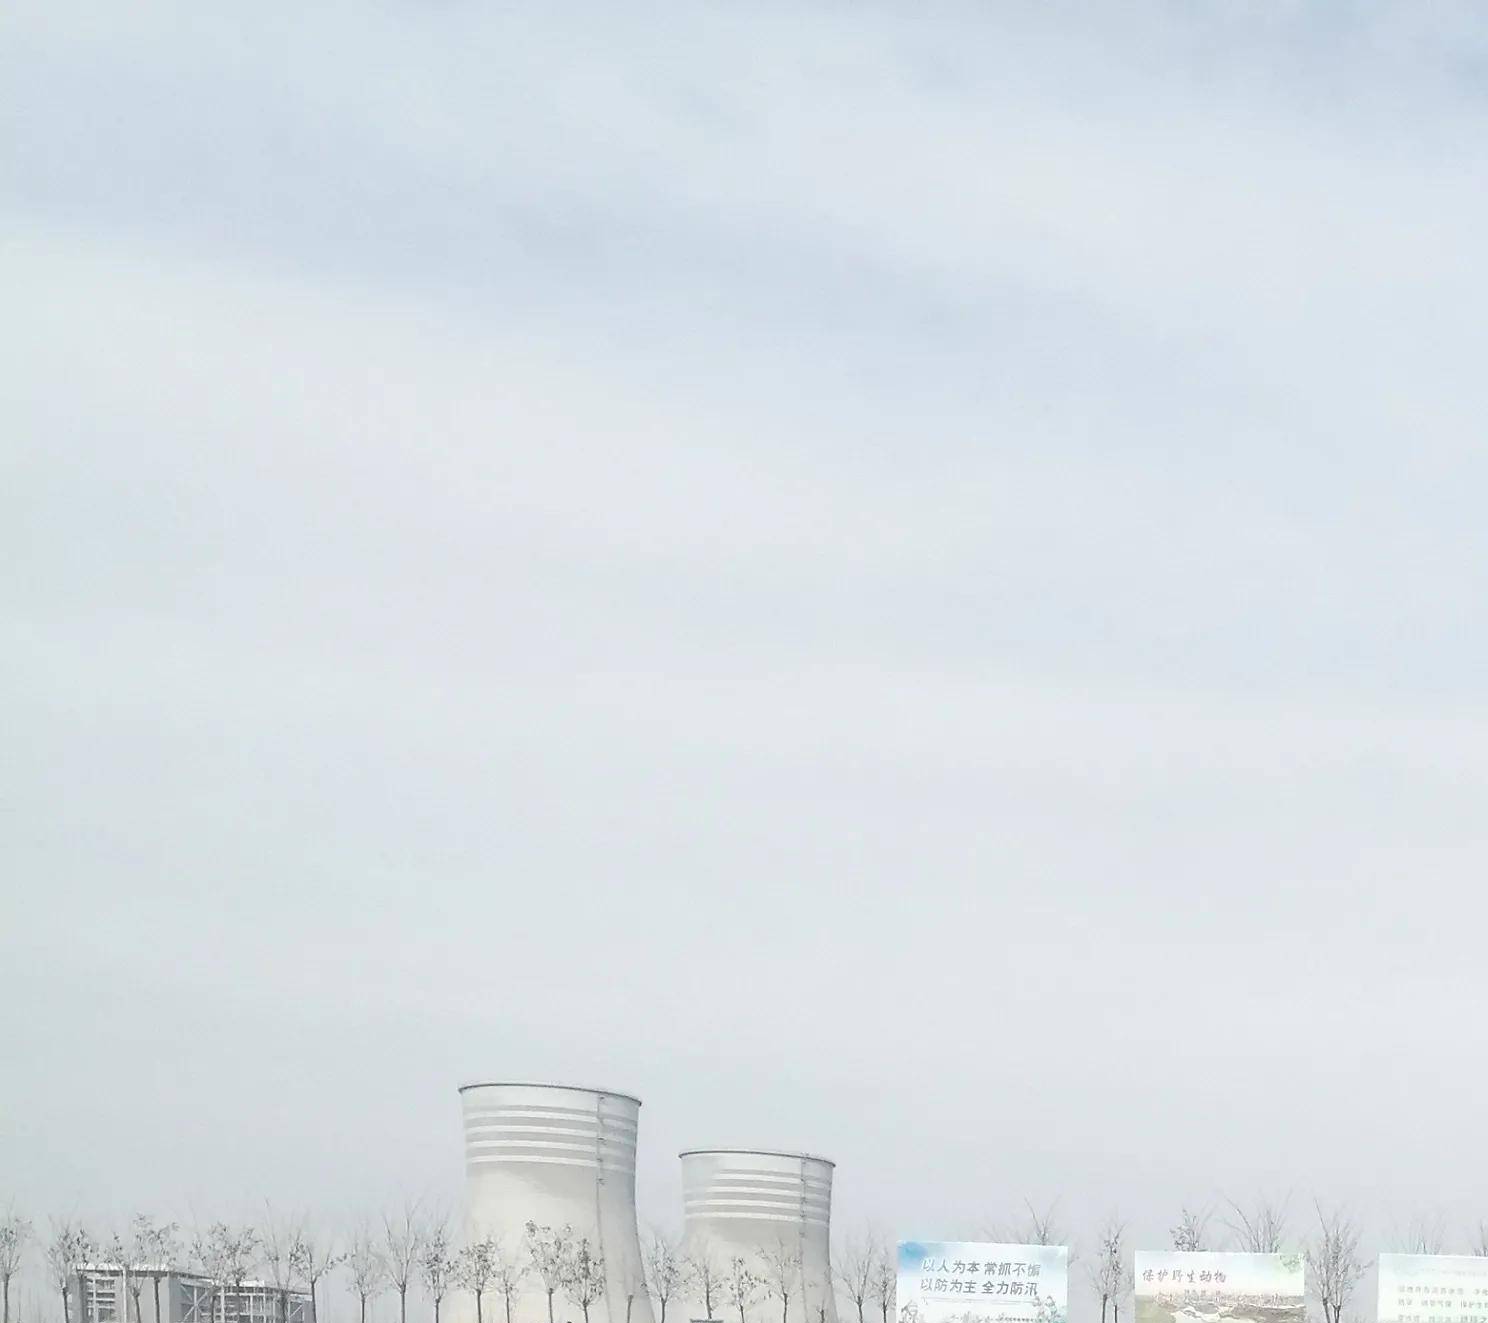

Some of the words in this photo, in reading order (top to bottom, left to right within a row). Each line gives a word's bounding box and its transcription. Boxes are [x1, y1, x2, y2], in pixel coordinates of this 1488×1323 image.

[922, 1258, 980, 1274] 以人为本
[1142, 1269, 1227, 1283] 保护野生动物
[920, 1278, 976, 1294] 以防为主
[981, 1280, 1038, 1296] 全力防汛
